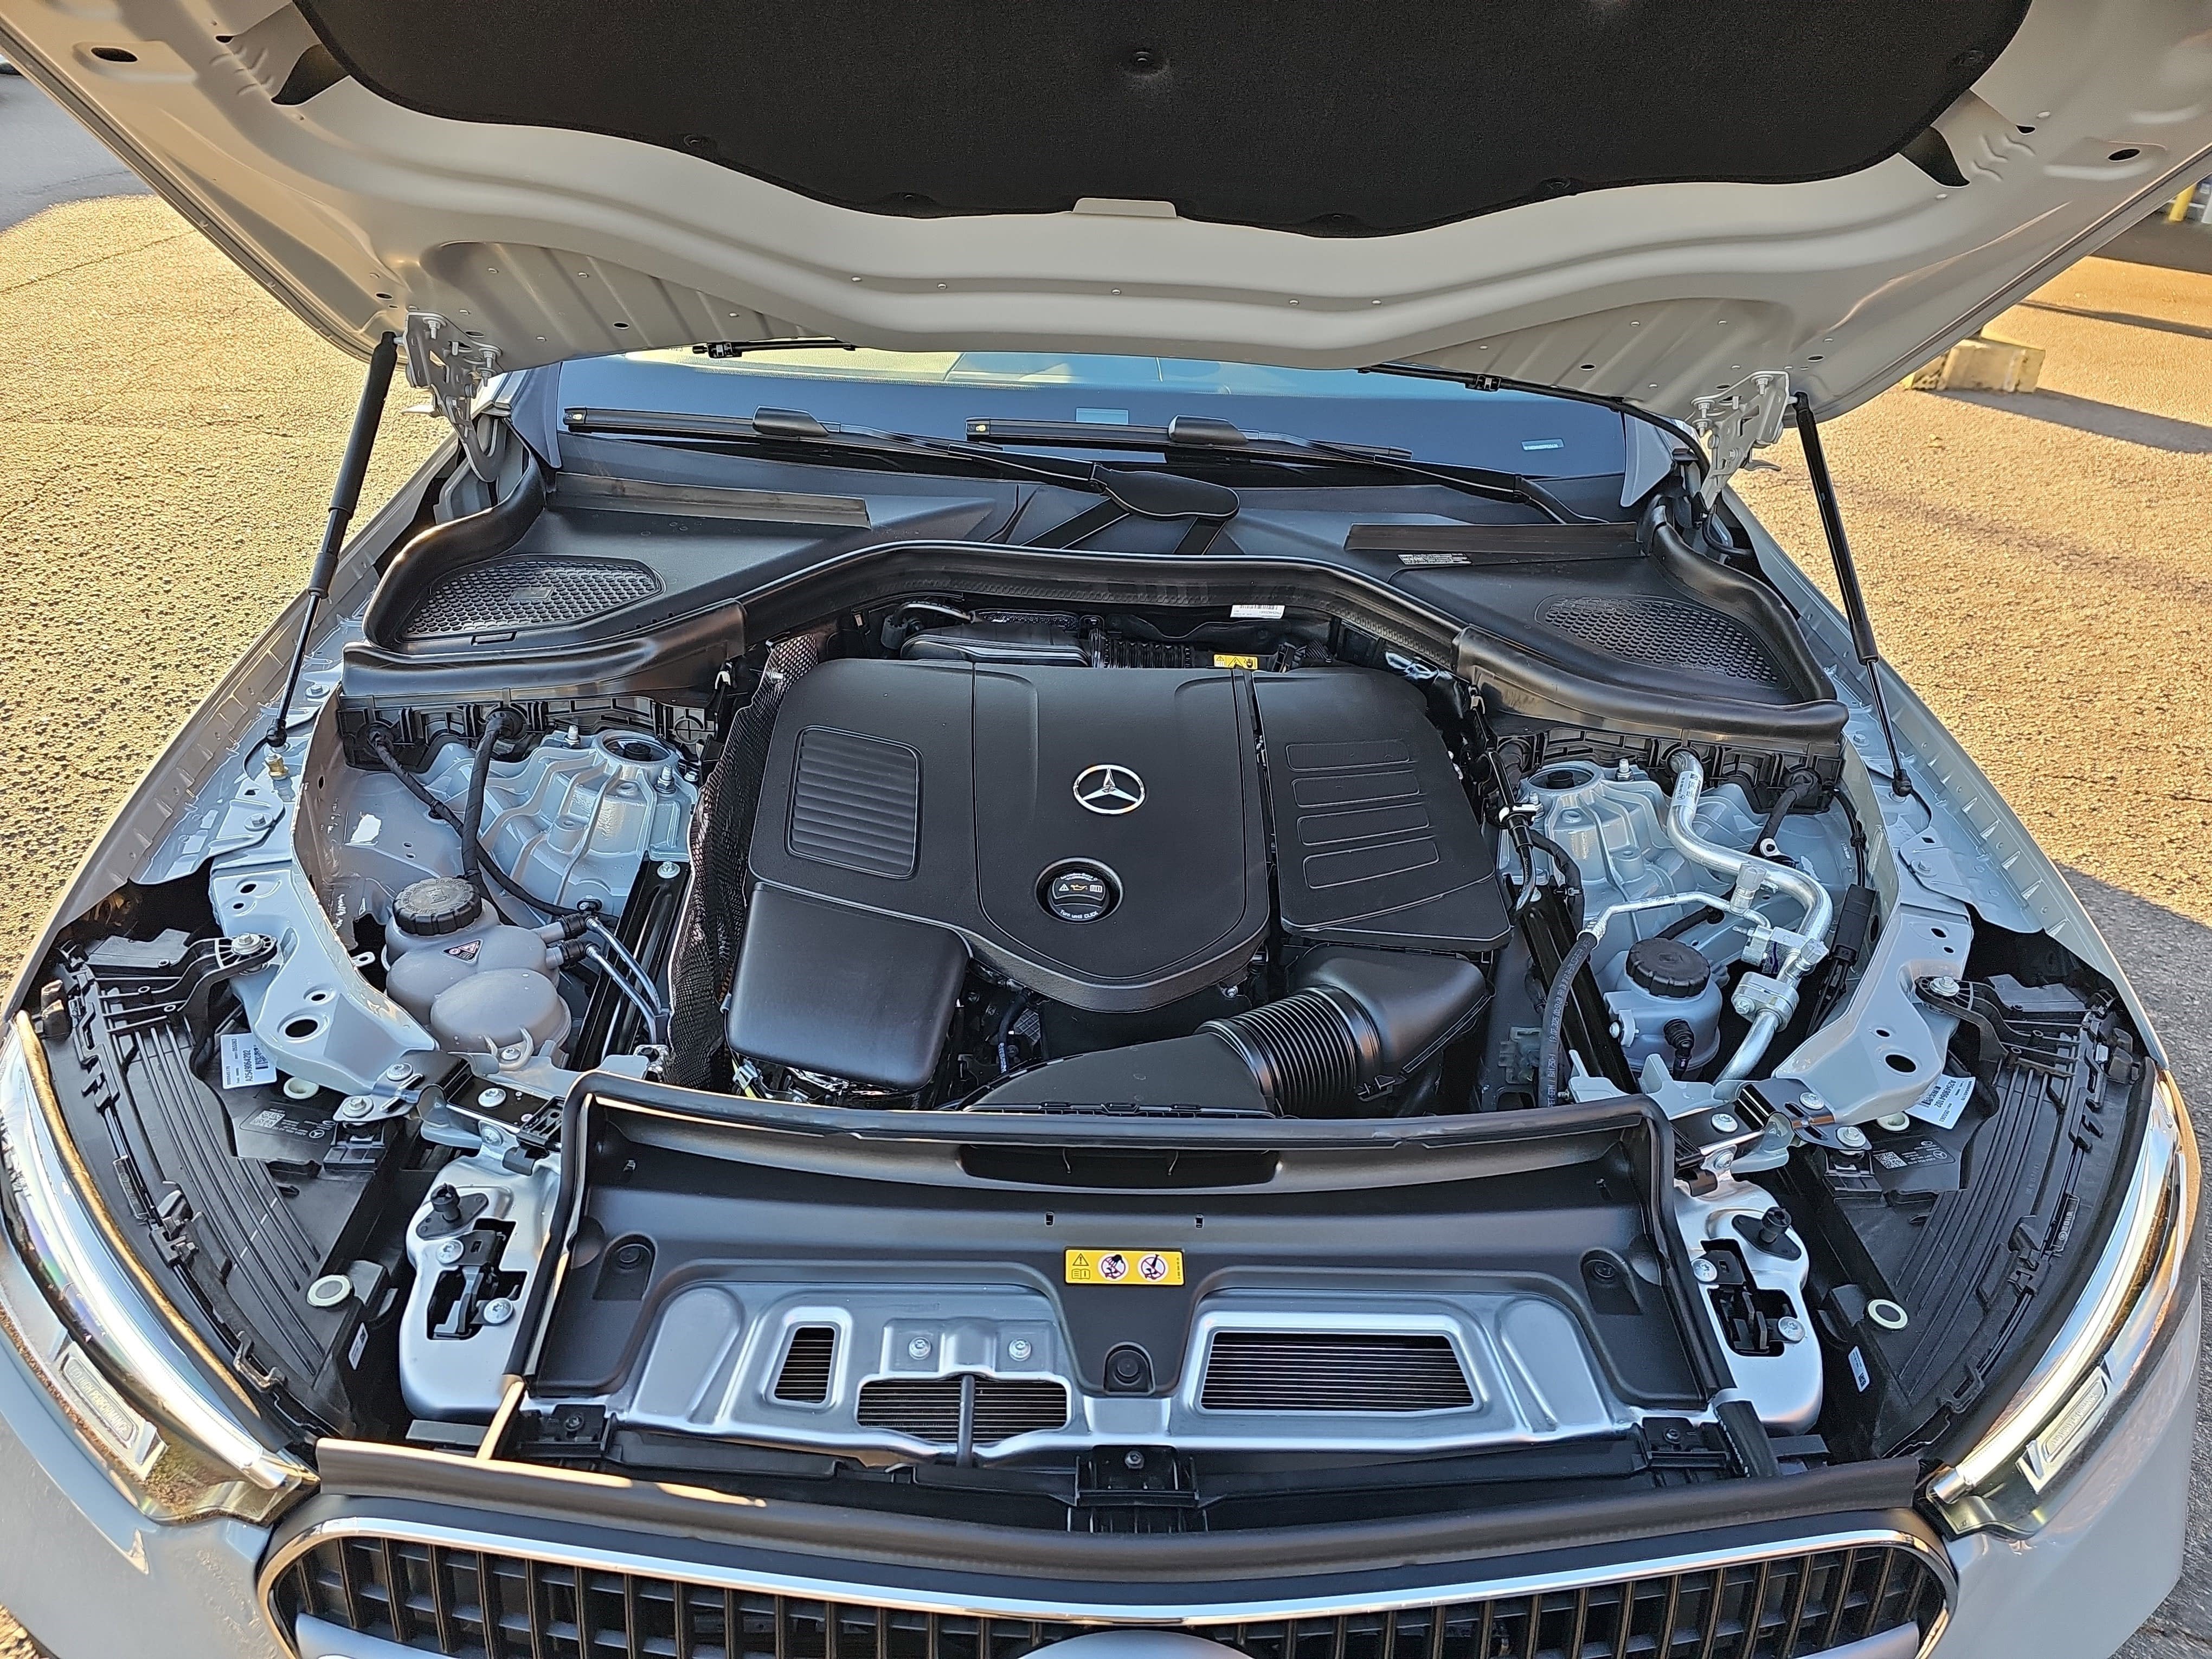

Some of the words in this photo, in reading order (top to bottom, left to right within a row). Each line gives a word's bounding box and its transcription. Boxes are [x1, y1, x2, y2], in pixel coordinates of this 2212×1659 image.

[243, 1050, 253, 1082] A2549064202
[1934, 1080, 1956, 1108] A2549064102
[68, 1366, 82, 1378] LED
[77, 1377, 94, 1394] HIGH
[89, 1390, 130, 1435] PERFORMANCE
[2069, 1392, 2098, 1427] PERFORMANCE
